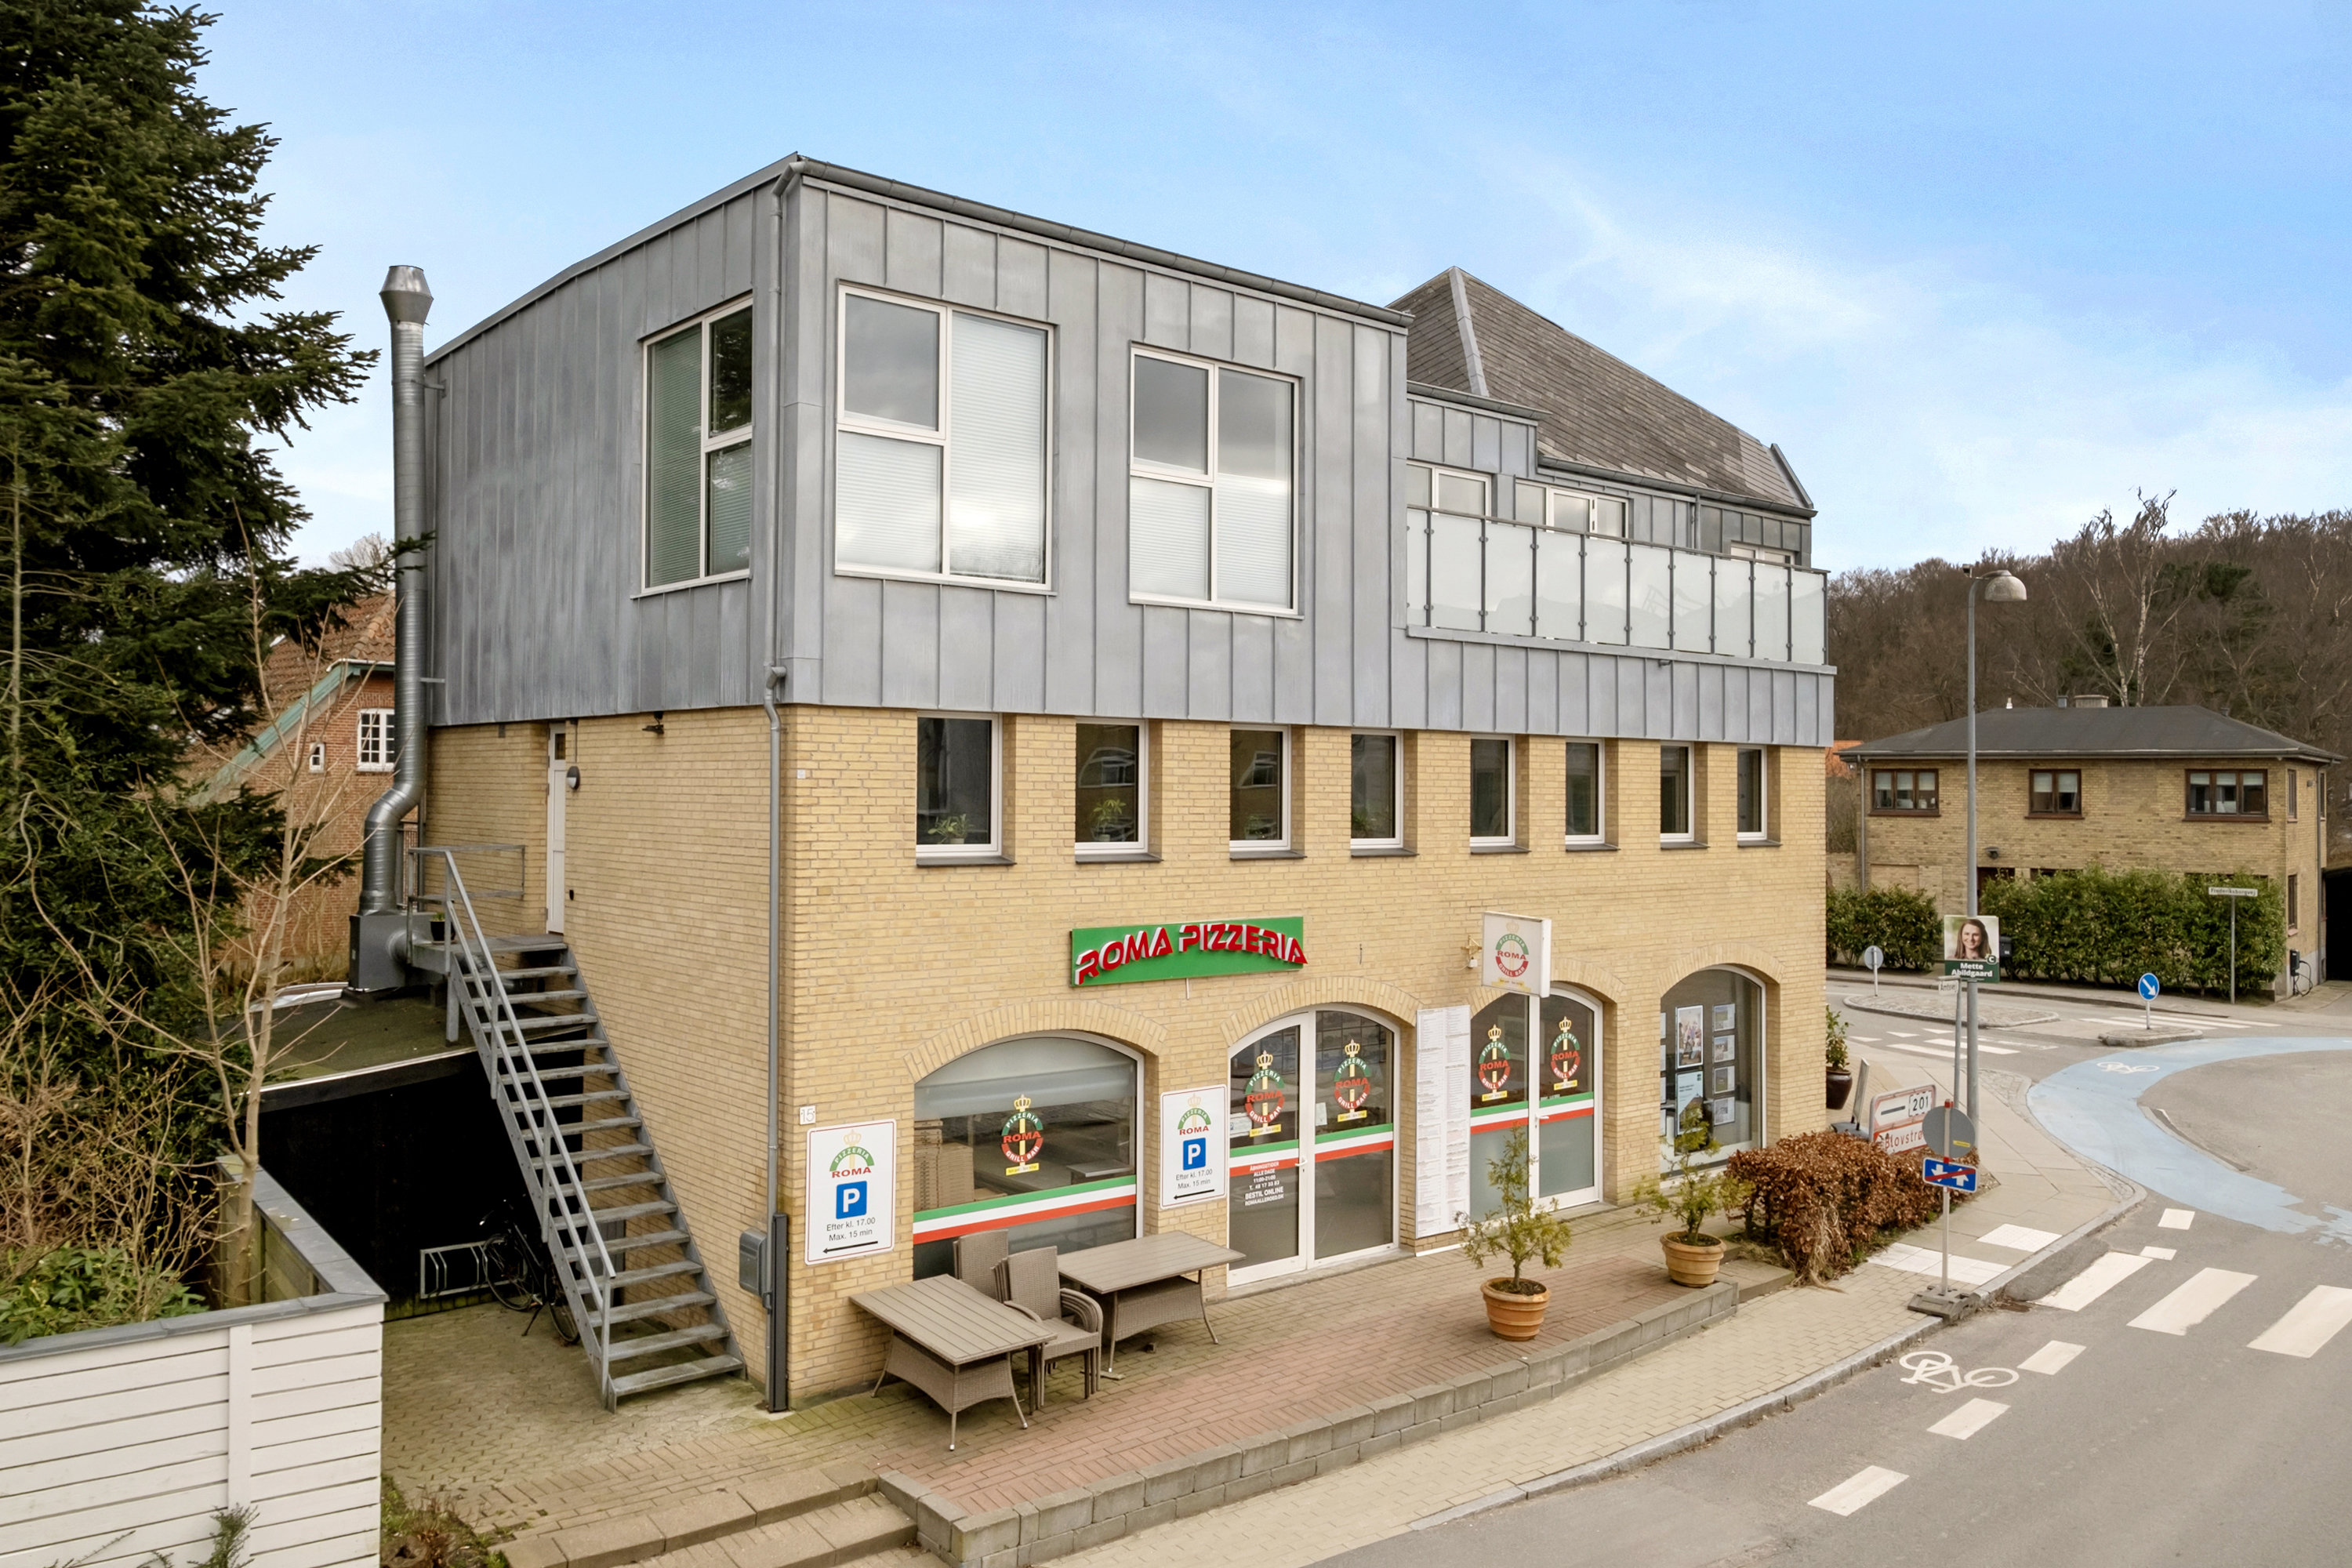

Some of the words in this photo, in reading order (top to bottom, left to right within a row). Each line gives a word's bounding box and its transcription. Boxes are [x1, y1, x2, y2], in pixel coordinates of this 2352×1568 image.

[1500, 935, 1525, 947] PIZZERIA
[1075, 927, 1173, 985] ROMA
[1178, 923, 1308, 964] PIZZERIA
[1497, 950, 1526, 960] ROMA
[1498, 963, 1513, 976] GRILL
[1515, 966, 1525, 975] BAR
[1951, 969, 1993, 978] Abildgaard
[1553, 1033, 1577, 1047] PIZZERIA
[1482, 1042, 1507, 1057] PIZZERIA
[1552, 1051, 1579, 1061] ROMA
[1338, 1058, 1367, 1073] PIZZERIA
[1480, 1060, 1508, 1071] ROMA
[1553, 1067, 1567, 1078] GRILL
[1568, 1064, 1578, 1076] BAR
[1249, 1069, 1281, 1087] PIZZERIA
[1336, 1077, 1368, 1088] ROMA
[1482, 1078, 1496, 1089] GRILL
[1497, 1074, 1508, 1087] BAR
[1246, 1090, 1283, 1102] ROMA
[1338, 1096, 1354, 1109] GRILL
[1356, 1092, 1367, 1106] BAR
[1913, 1096, 1929, 1111] 201
[801, 1108, 815, 1123] 15
[1006, 1112, 1038, 1128] PIZZERIA
[1181, 1109, 1207, 1122] PIZZERIA
[1250, 1110, 1267, 1123] GRILL
[1269, 1106, 1282, 1120] BAR
[1004, 1131, 1041, 1143] ROMA
[1179, 1125, 1209, 1135] ROMA
[1885, 1131, 1922, 1149] Blovstrø
[835, 1146, 869, 1163] PIZZERIA
[1006, 1150, 1024, 1162] GRILL
[1026, 1146, 1040, 1160] BAR
[1188, 1144, 1201, 1165] P
[832, 1167, 871, 1178] ROMA
[1245, 1190, 1263, 1200] BESTIL
[1264, 1186, 1283, 1196] ONLINE
[843, 1188, 860, 1213] P
[826, 1221, 844, 1232] Efter
[856, 1217, 876, 1227] 17.00
[829, 1233, 846, 1242] Max.
[849, 1230, 858, 1239] 15
